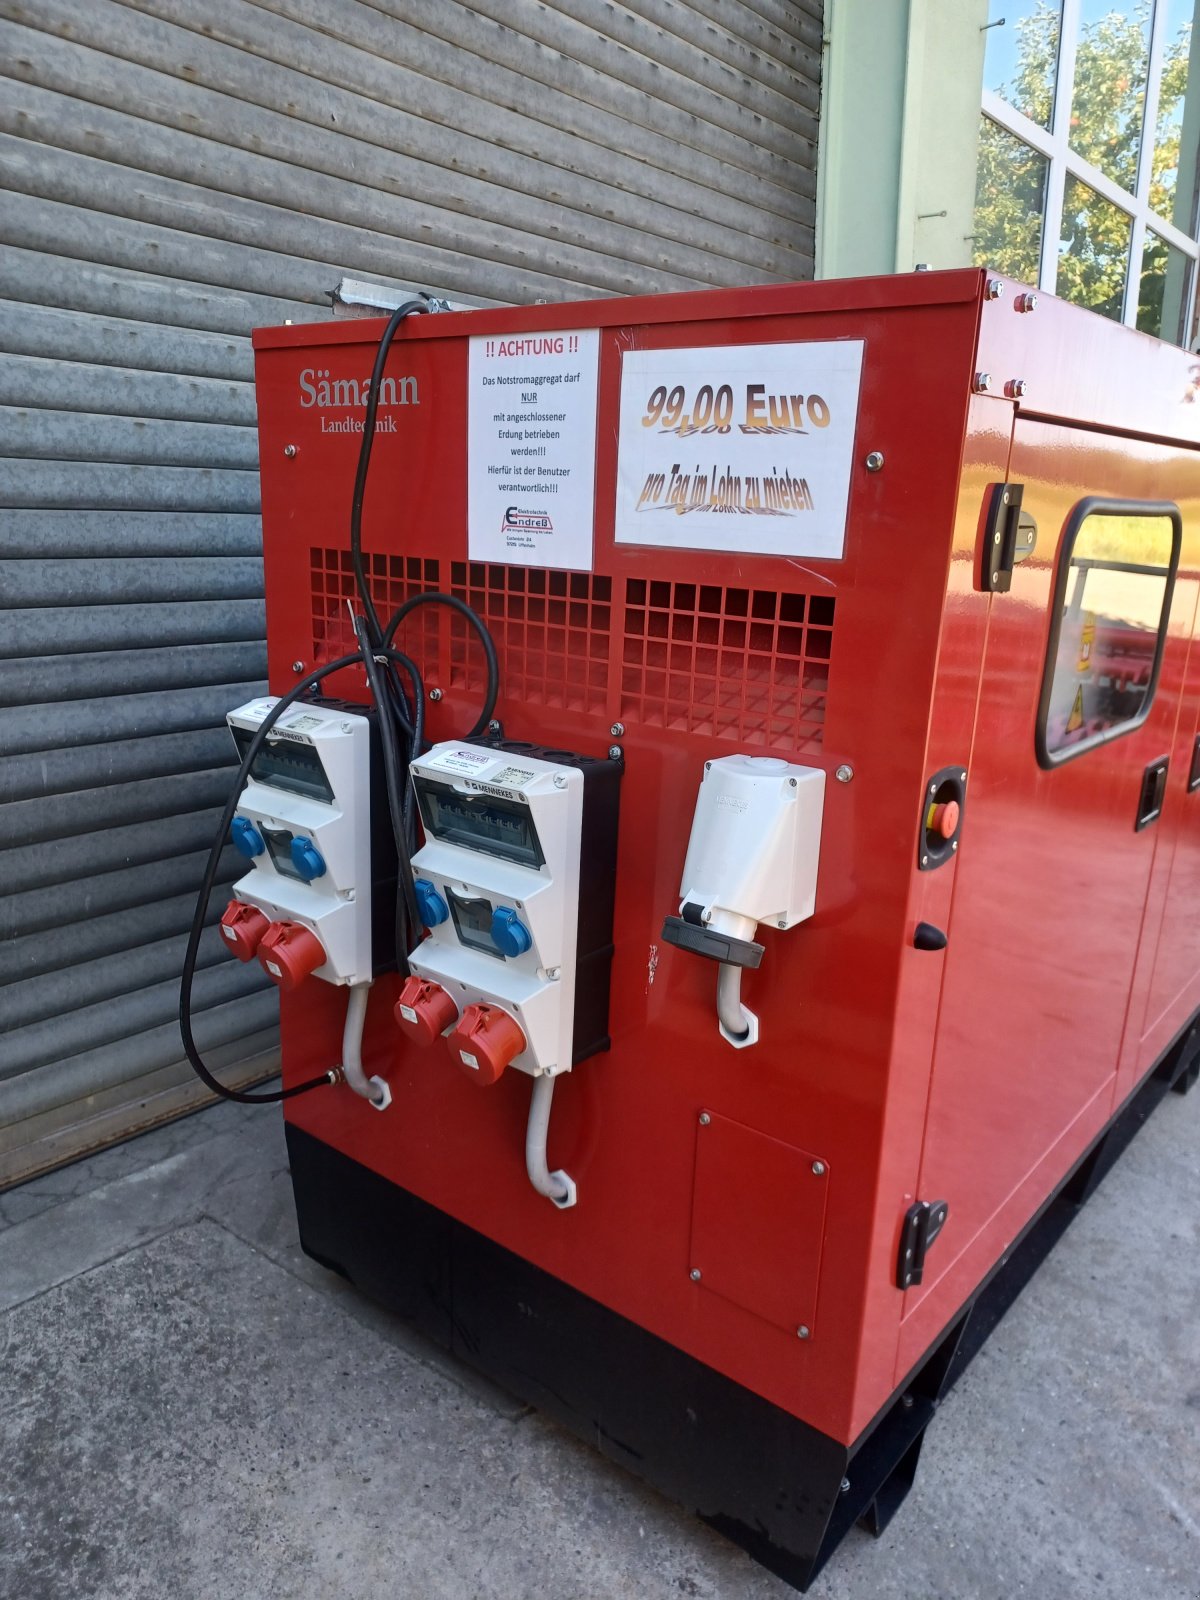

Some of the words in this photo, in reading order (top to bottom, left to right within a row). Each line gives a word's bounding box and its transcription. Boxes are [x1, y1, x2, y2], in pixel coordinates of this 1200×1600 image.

[485, 341, 495, 358] !!
[498, 337, 564, 358] ACHTUNG
[568, 335, 579, 353] !!
[482, 376, 496, 386] Das
[497, 373, 562, 387] Notstromaggregat
[564, 372, 581, 384] darf
[521, 392, 538, 402] NUR
[641, 384, 734, 436] 99,00
[745, 384, 831, 429] Euro
[320, 415, 397, 433] Landtecnik
[493, 412, 506, 423] mit
[506, 412, 567, 424] angeschlossener
[498, 429, 523, 441] Erdung
[524, 428, 560, 440] betrieben
[510, 446, 547, 457] werden!!!
[487, 465, 513, 476] Hierfür
[513, 465, 523, 476] ist
[523, 465, 536, 477] der
[537, 466, 571, 477] Benutzer
[498, 483, 559, 494] verantwortlich!!!
[635, 473, 666, 512] pro
[665, 464, 690, 515] Tag
[690, 464, 708, 506] im
[710, 464, 741, 508] Lohn
[744, 476, 761, 509] zu
[762, 466, 815, 511] mieten
[478, 783, 514, 799] MENNEKES
